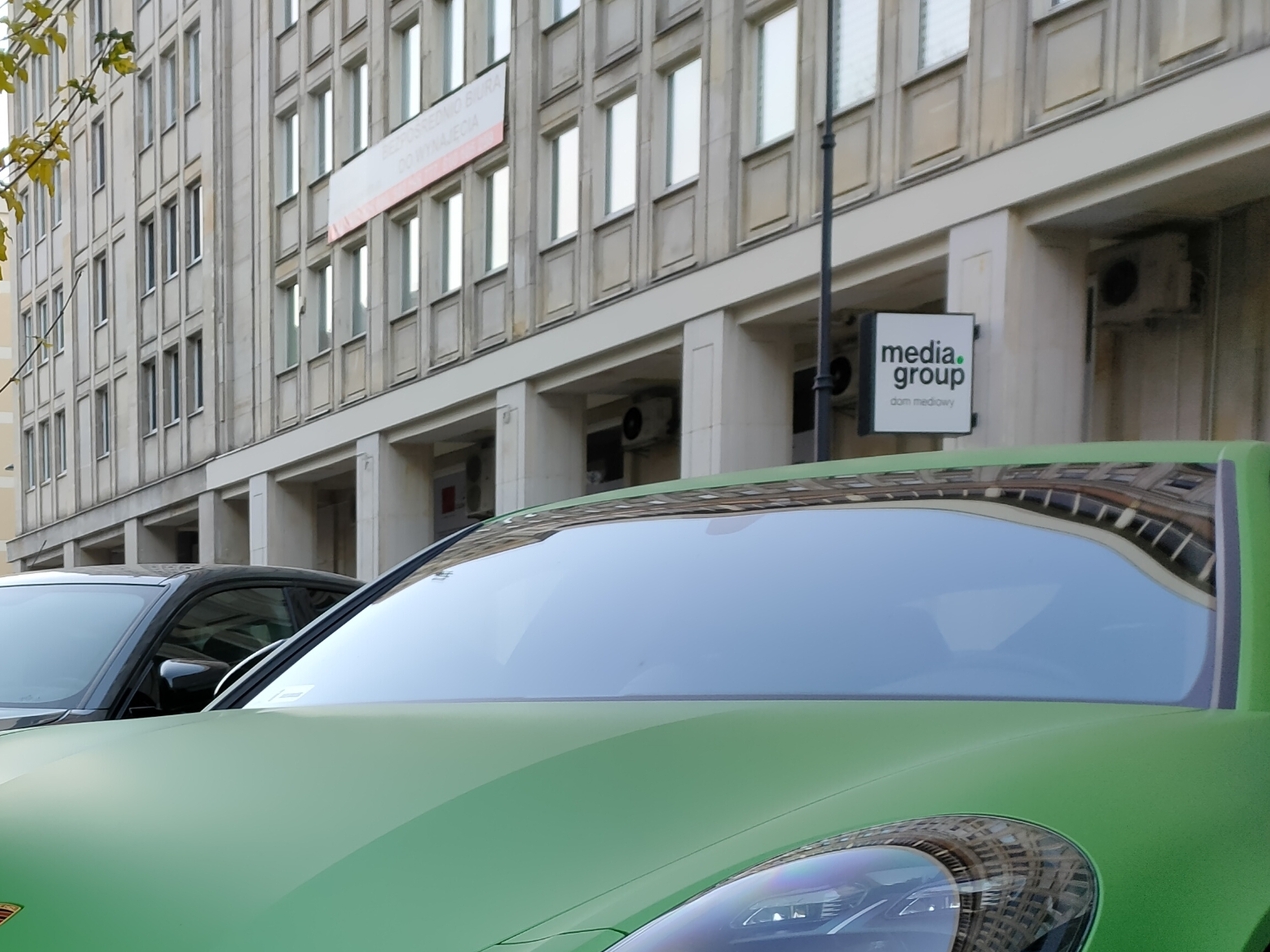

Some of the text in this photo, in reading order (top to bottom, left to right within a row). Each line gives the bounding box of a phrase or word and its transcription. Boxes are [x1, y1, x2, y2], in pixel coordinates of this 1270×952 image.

[399, 156, 415, 174] DO
[893, 366, 965, 390] group
[890, 397, 955, 408] dom mediowy
